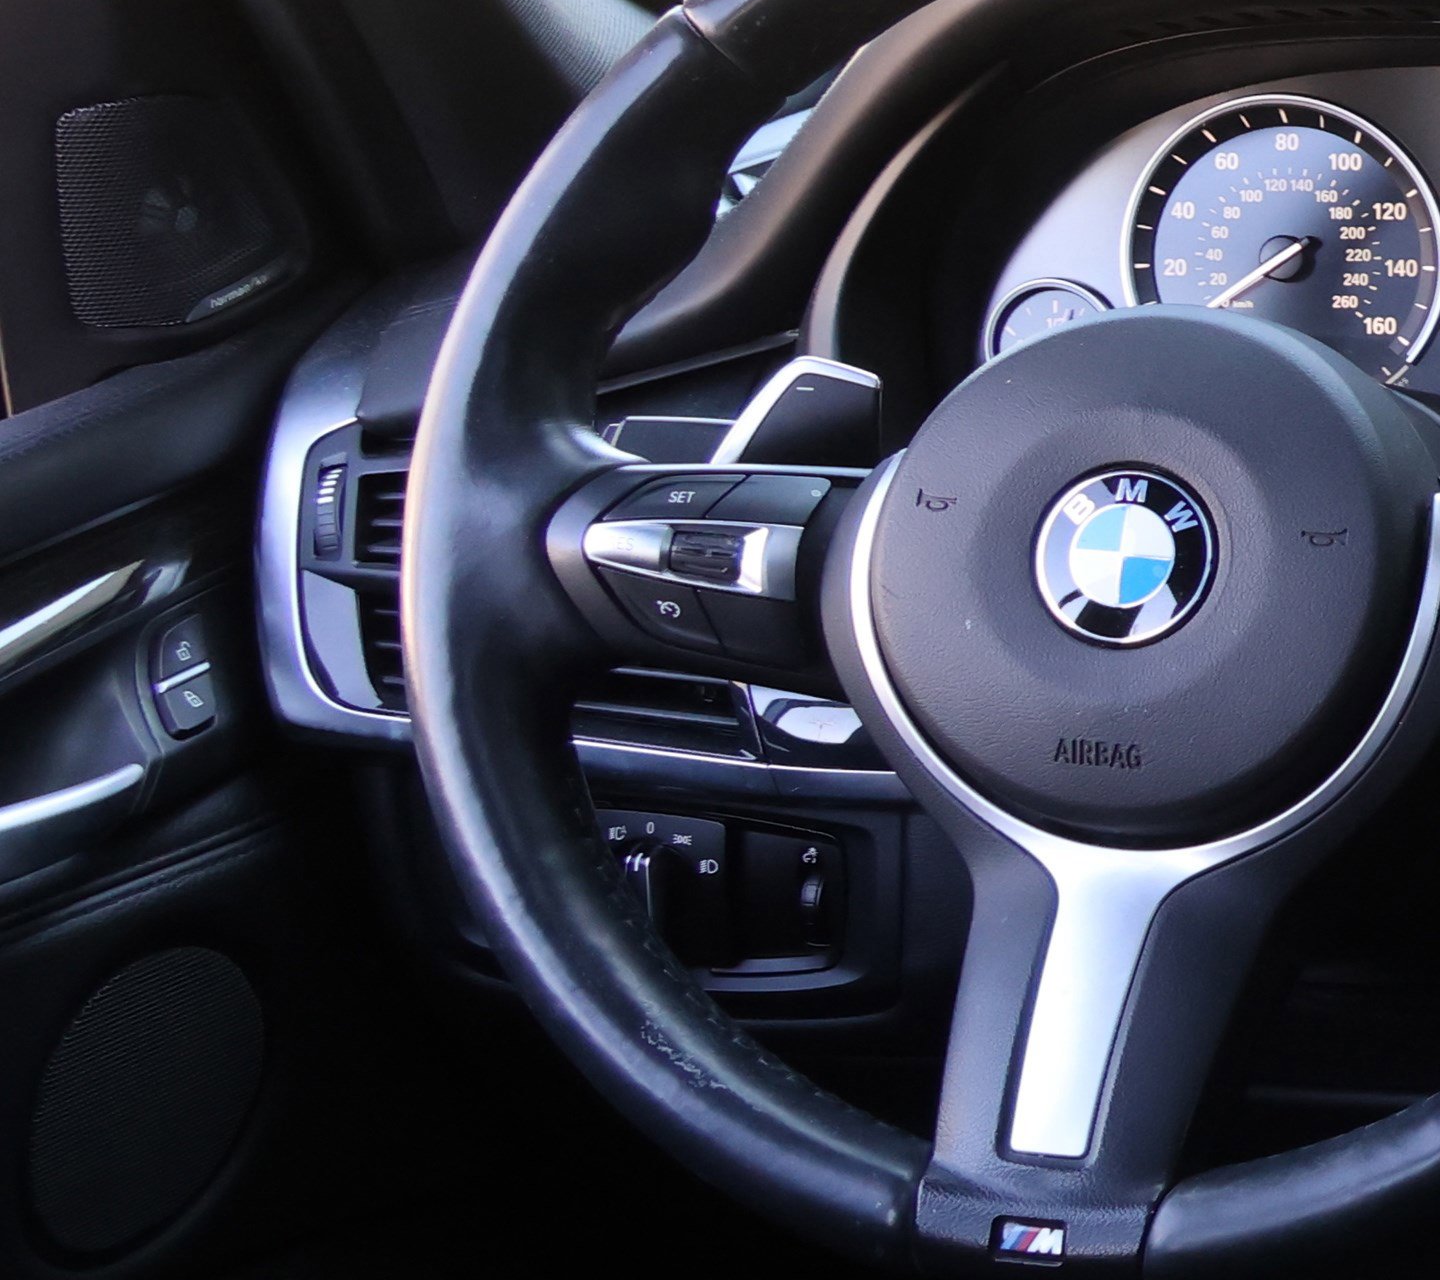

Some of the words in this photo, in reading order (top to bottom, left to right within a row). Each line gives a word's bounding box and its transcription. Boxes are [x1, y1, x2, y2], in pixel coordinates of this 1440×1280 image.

[1275, 133, 1300, 152] 80
[1214, 152, 1239, 171] 60
[1327, 152, 1362, 171] 100
[1264, 179, 1287, 192] 120
[1291, 179, 1314, 192] 140
[1239, 189, 1263, 203] 100
[1314, 190, 1338, 204] 160
[1171, 201, 1196, 220] 40
[1223, 206, 1241, 219] 80
[1328, 206, 1353, 220] 180
[1371, 202, 1407, 221] 120
[1211, 226, 1229, 240] 60
[1339, 226, 1366, 240] 200
[1205, 248, 1223, 262] 40
[1345, 248, 1372, 262] 220
[1163, 258, 1187, 277] 20
[1385, 258, 1418, 278] 140
[1210, 272, 1228, 286] 20
[1343, 273, 1369, 287] 240
[1232, 299, 1254, 308] km/h
[1331, 294, 1359, 309] 260
[1363, 316, 1397, 336] 160
[668, 490, 696, 504] SET
[1062, 478, 1199, 533] BMW
[1053, 736, 1143, 770] AIRBAG
